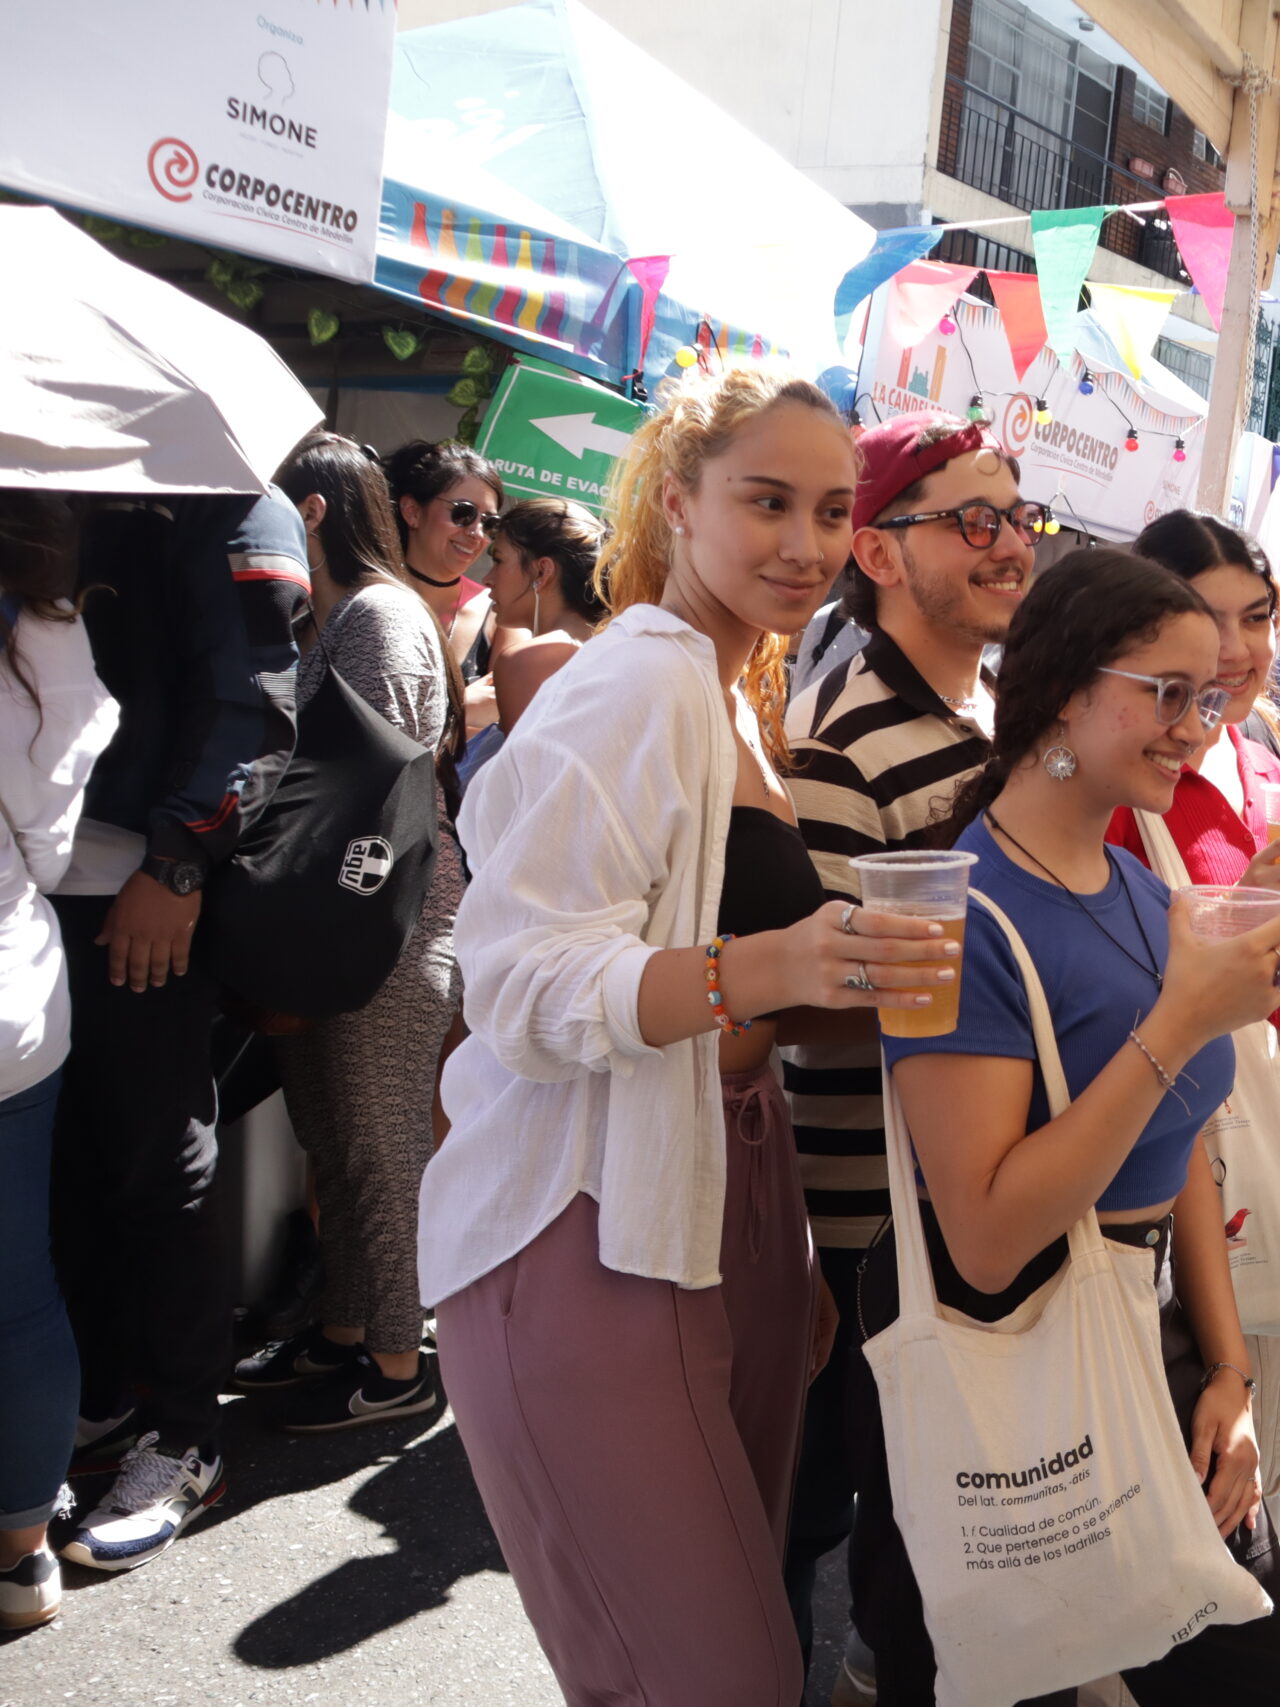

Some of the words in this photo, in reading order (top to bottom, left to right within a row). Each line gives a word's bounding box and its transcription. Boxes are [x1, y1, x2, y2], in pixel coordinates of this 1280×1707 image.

[256, 14, 304, 45] Organiza
[226, 96, 318, 150] SIMONE
[205, 163, 358, 233] CORPOCENTRO
[281, 214, 308, 230] Centro
[309, 223, 320, 235] de
[872, 381, 887, 405] LA
[1034, 420, 1119, 471] CORPOCENTRO
[494, 458, 536, 480] RUTA
[539, 470, 562, 487] DE
[344, 844, 367, 884] agv
[956, 1434, 1094, 1490] comunidad
[958, 1495, 978, 1507] Del
[980, 1495, 998, 1507] lat.
[961, 1526, 969, 1538] 1.
[979, 1521, 1036, 1538] Cualidad
[1038, 1516, 1055, 1531] de
[1057, 1495, 1102, 1524] común.
[963, 1542, 975, 1554] 2.
[976, 1541, 1002, 1555] Que
[1005, 1528, 1070, 1555] pertenece
[1071, 1524, 1081, 1535] o
[1082, 1516, 1097, 1531] se
[1098, 1482, 1142, 1522] extiende
[966, 1557, 995, 1571] más
[997, 1555, 1021, 1569] allá
[1024, 1552, 1041, 1566] de
[1043, 1547, 1062, 1561] los
[1064, 1526, 1112, 1555] ladrillos
[1171, 1601, 1218, 1643] IBERO
